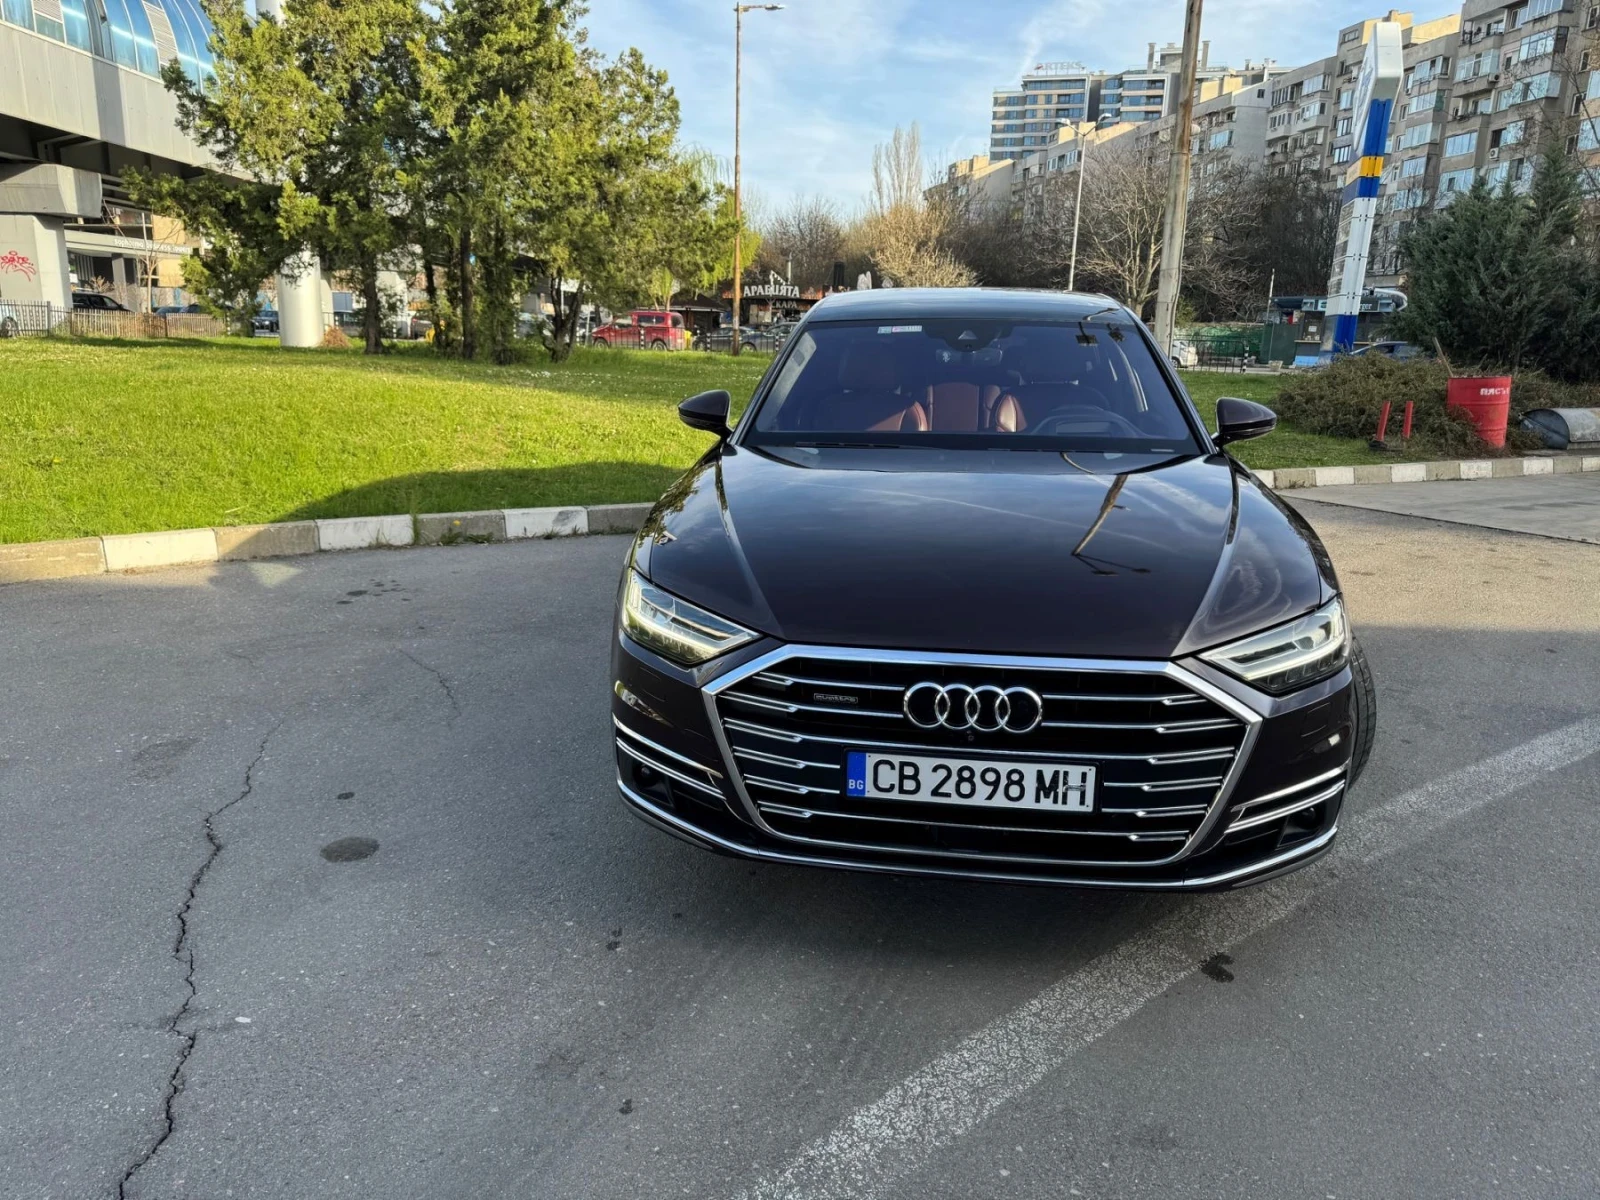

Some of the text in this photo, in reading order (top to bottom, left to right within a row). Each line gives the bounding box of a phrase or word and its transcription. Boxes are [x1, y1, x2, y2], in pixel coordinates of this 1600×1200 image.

[848, 779, 864, 790] BG
[872, 759, 1088, 806] CB 2898 MH
